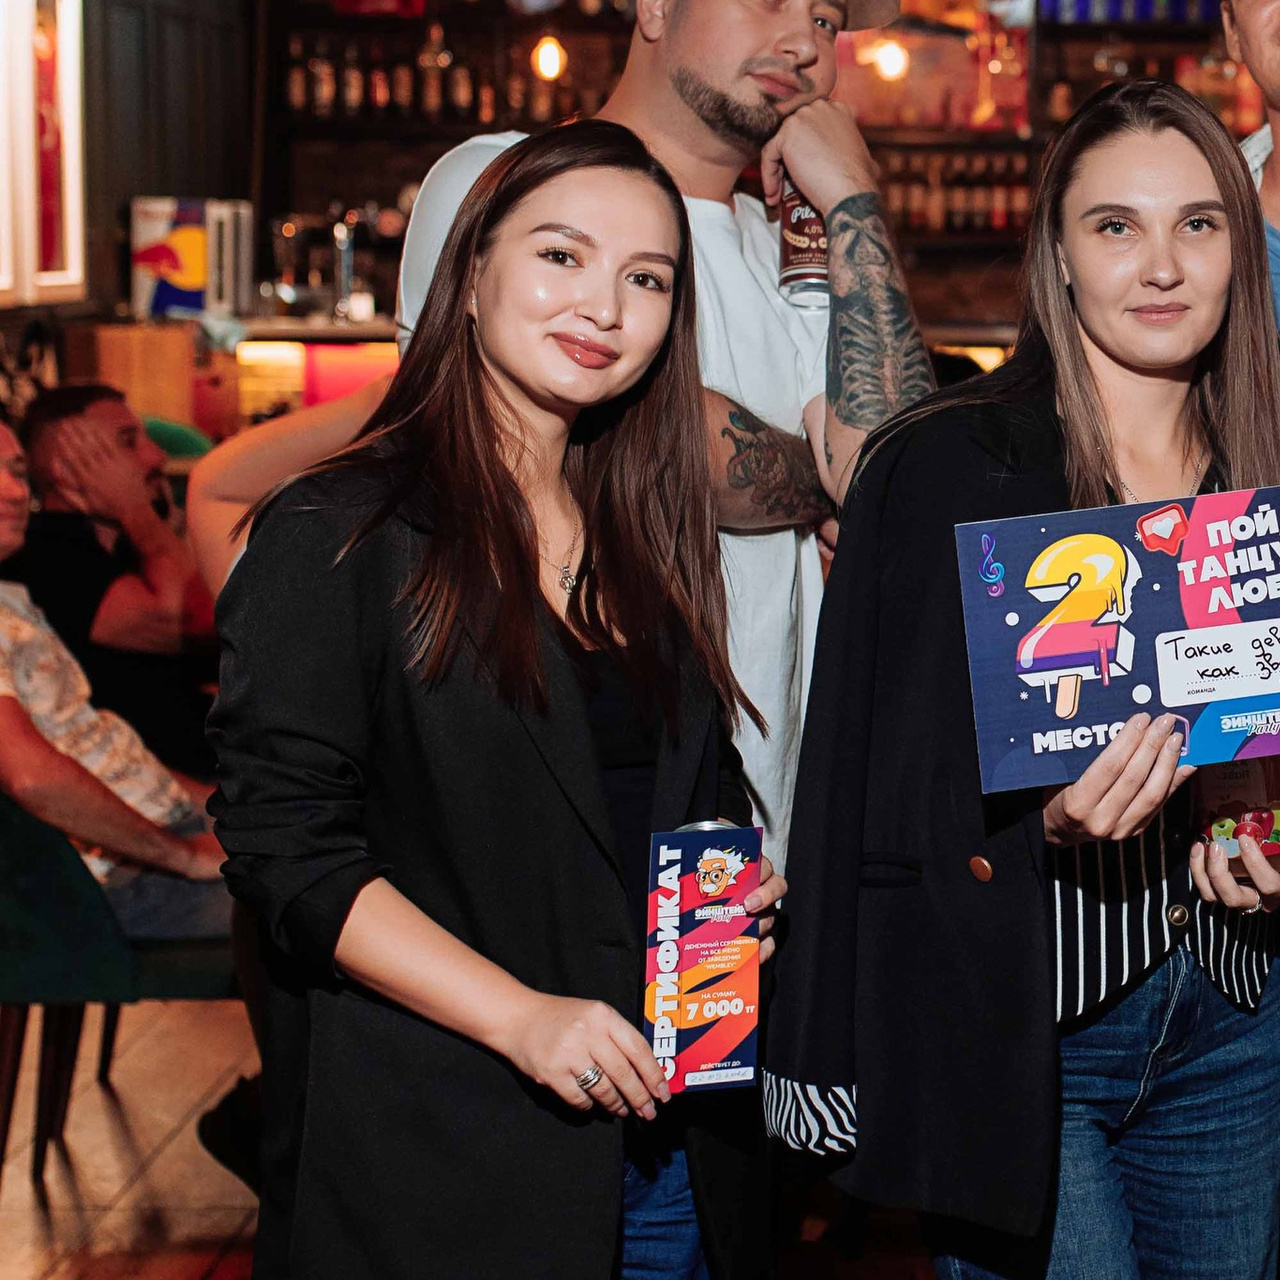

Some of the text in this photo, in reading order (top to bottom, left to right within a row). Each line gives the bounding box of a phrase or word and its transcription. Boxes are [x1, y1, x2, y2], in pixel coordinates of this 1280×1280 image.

[1015, 533, 1143, 686] 2
[1164, 635, 1234, 660] Такие
[1197, 665, 1240, 680] как
[1187, 687, 1217, 696] КОМАНДА
[653, 845, 683, 1081] СЕРТИФИКАТ
[686, 1002, 699, 1020] 7
[702, 998, 744, 1018] 000
